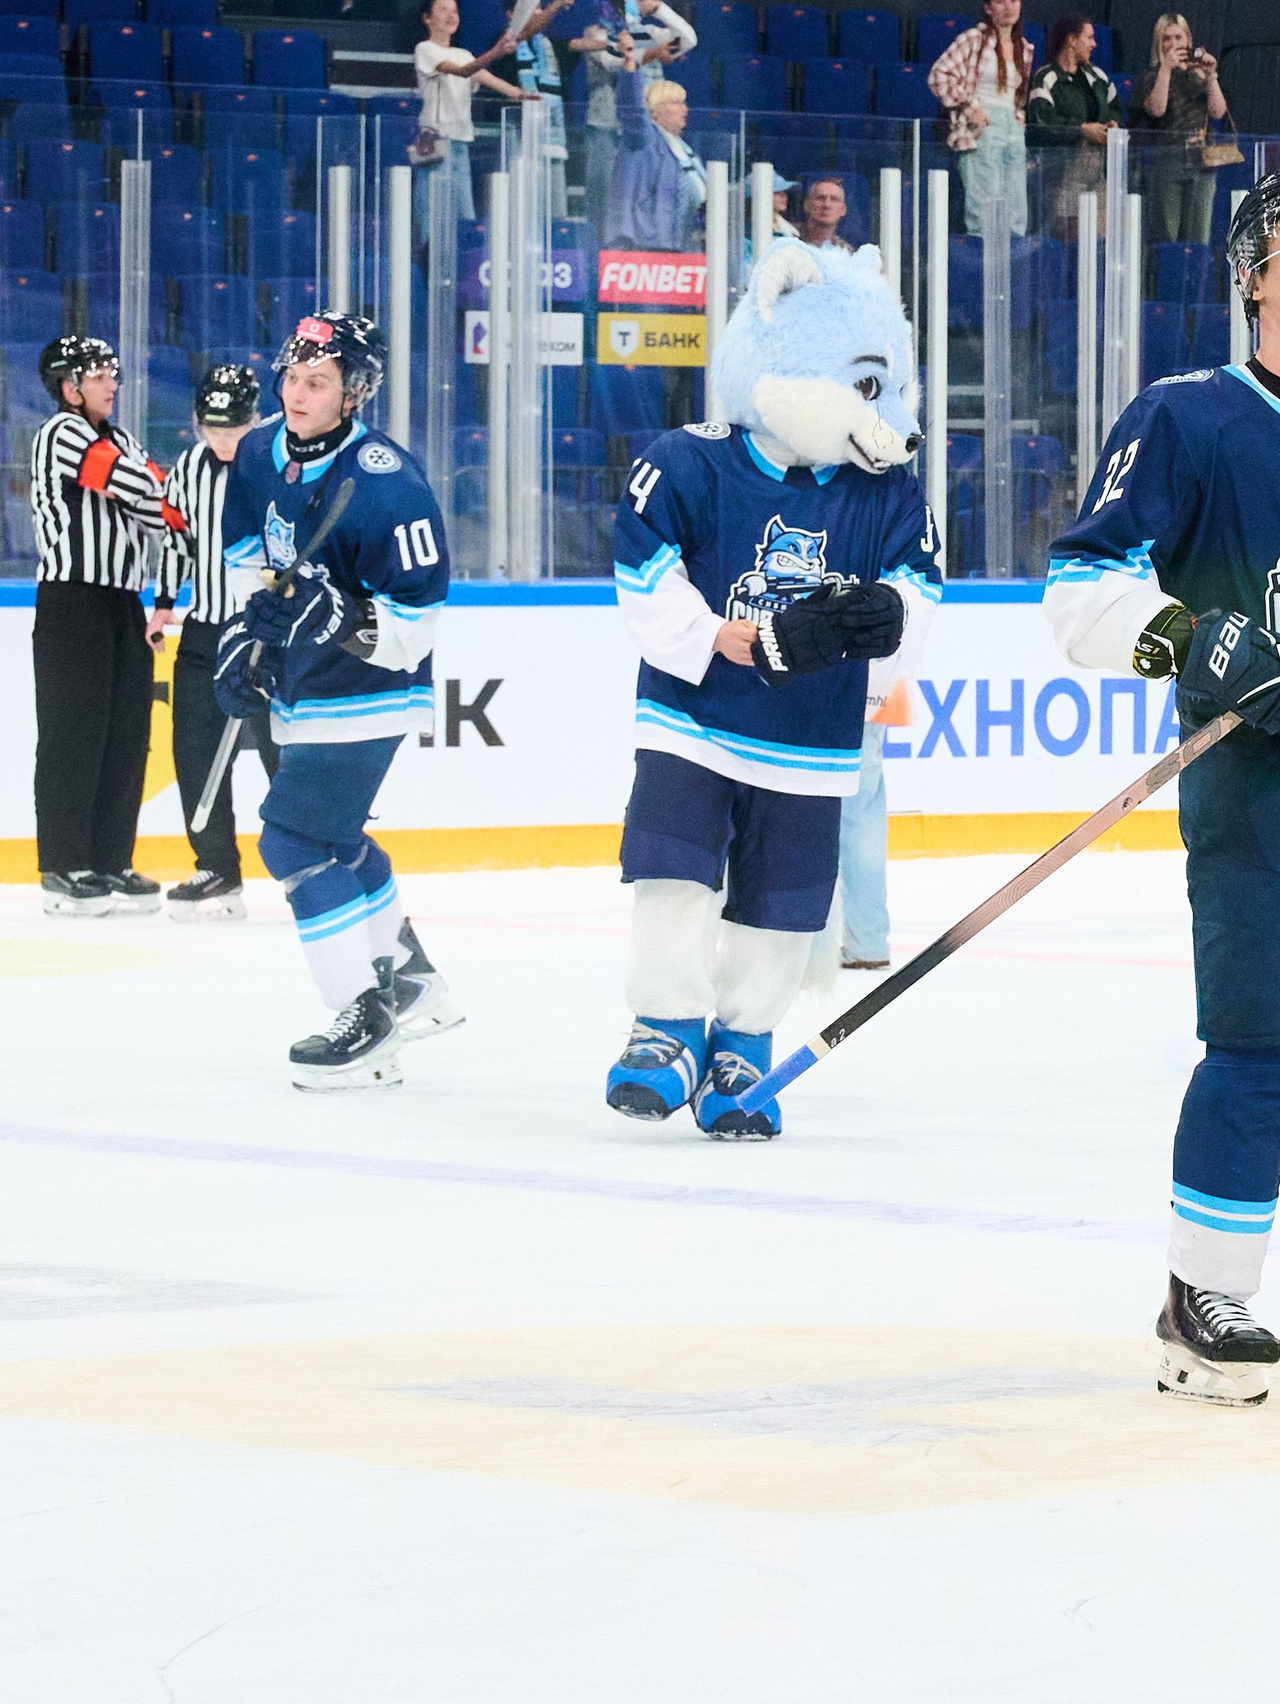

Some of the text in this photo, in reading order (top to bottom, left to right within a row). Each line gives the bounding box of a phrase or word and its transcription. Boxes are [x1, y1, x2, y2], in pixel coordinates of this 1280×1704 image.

[601, 262, 707, 294] FONBET
[644, 332, 701, 349] БАНК
[208, 391, 231, 409] 33
[629, 457, 662, 515] 4
[1091, 438, 1141, 515] 32
[394, 518, 439, 571] 10
